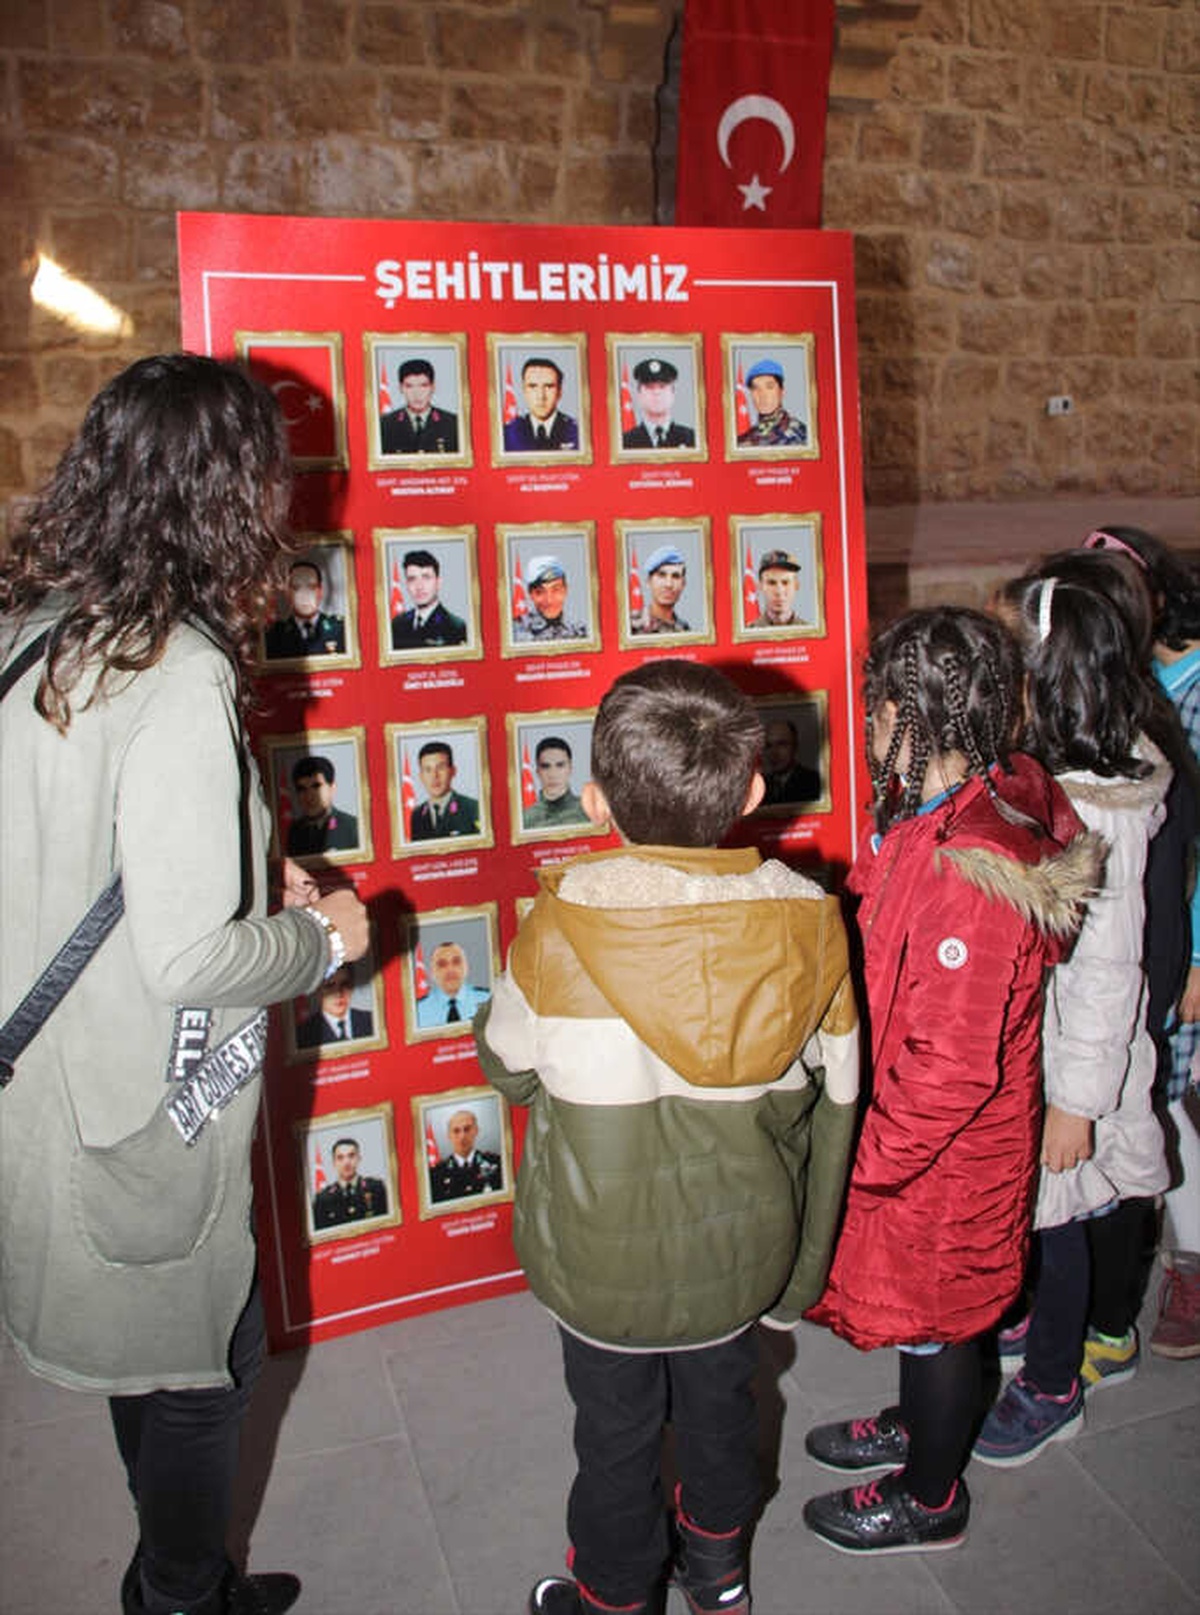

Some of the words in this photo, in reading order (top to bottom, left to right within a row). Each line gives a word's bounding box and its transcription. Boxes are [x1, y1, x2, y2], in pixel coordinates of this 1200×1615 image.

[374, 251, 690, 308] ŞEHİTLERİMİZ
[171, 1082, 204, 1136] ART
[197, 1044, 250, 1106] COMES
